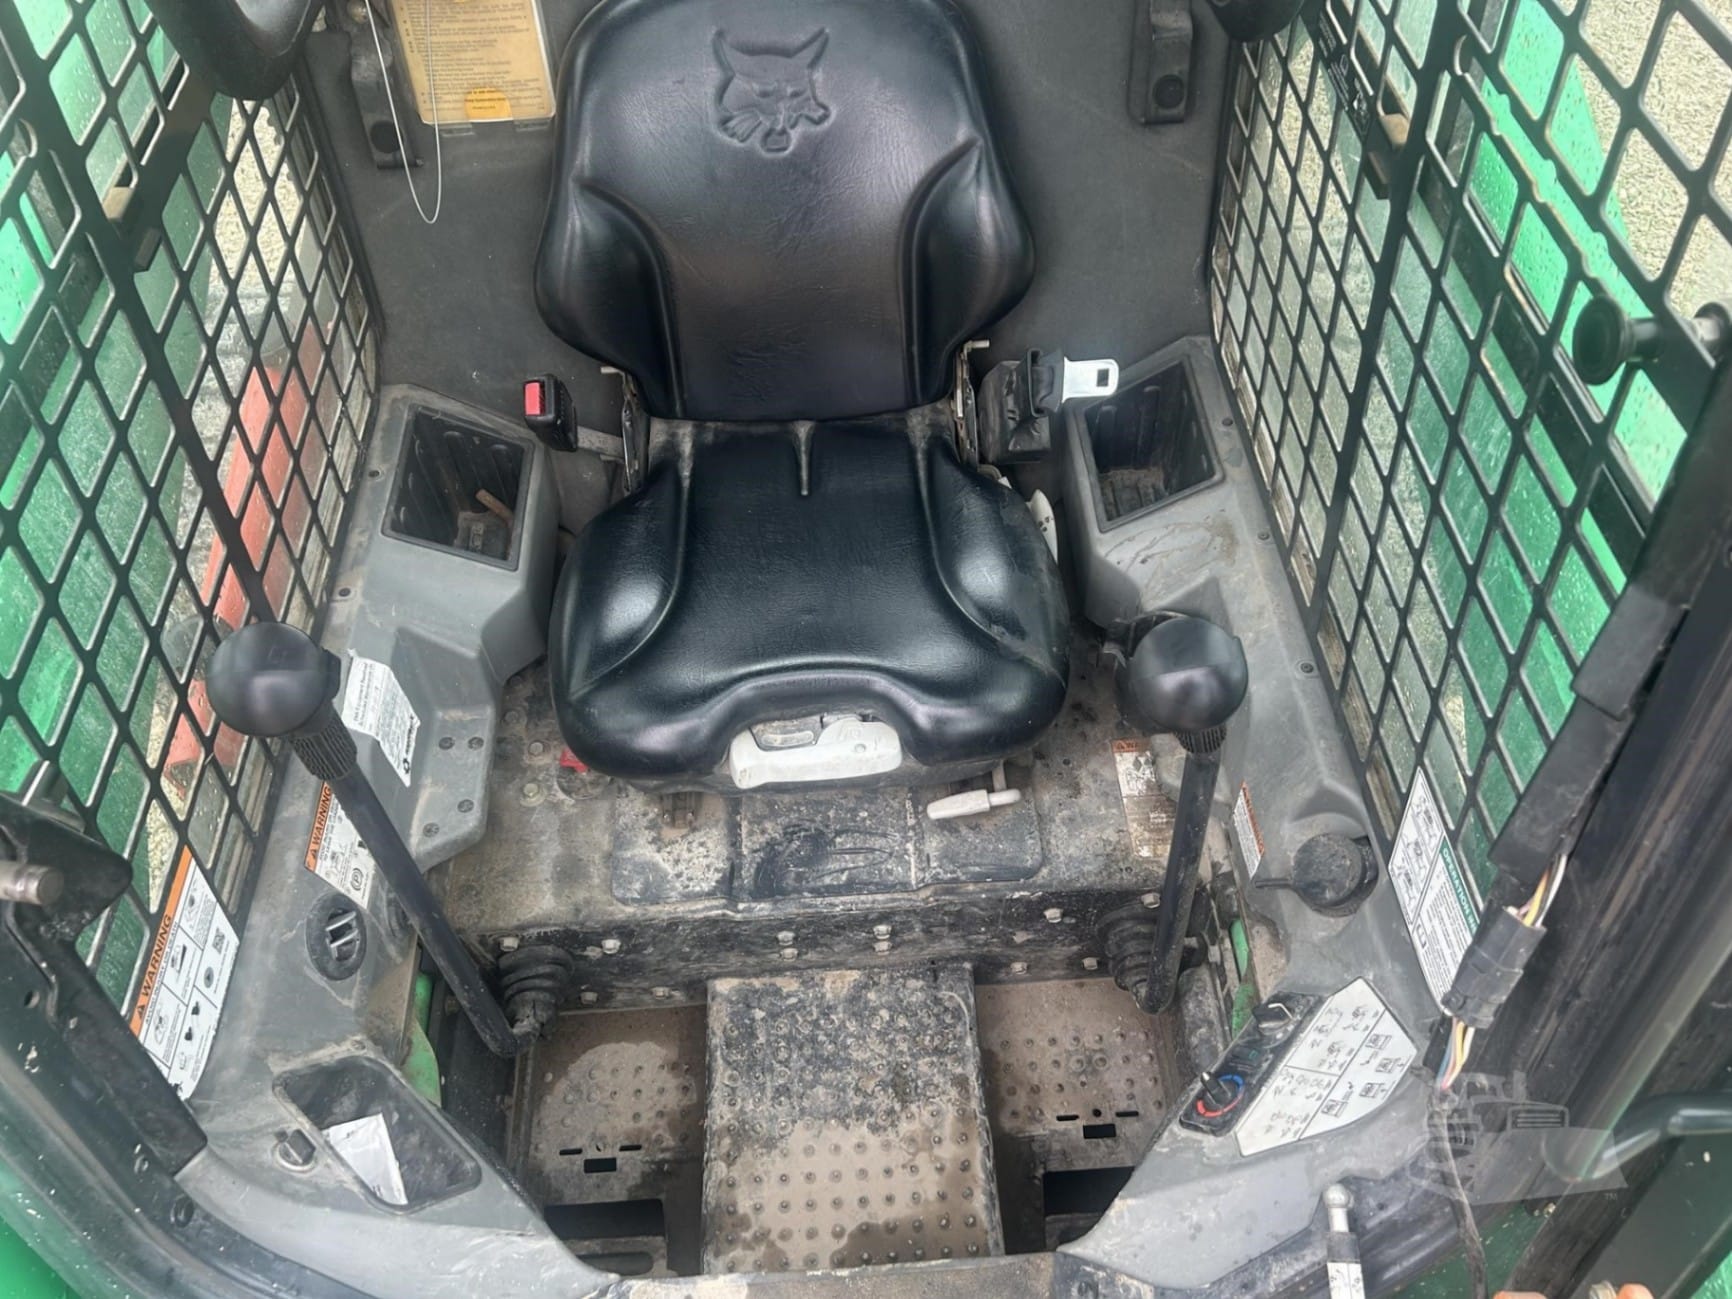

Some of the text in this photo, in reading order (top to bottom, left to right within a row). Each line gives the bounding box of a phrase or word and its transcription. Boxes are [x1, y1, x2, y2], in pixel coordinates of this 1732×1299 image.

[312, 785, 332, 845] WARNING
[1443, 847, 1471, 915] OPERATION
[142, 913, 172, 997] WARNING
